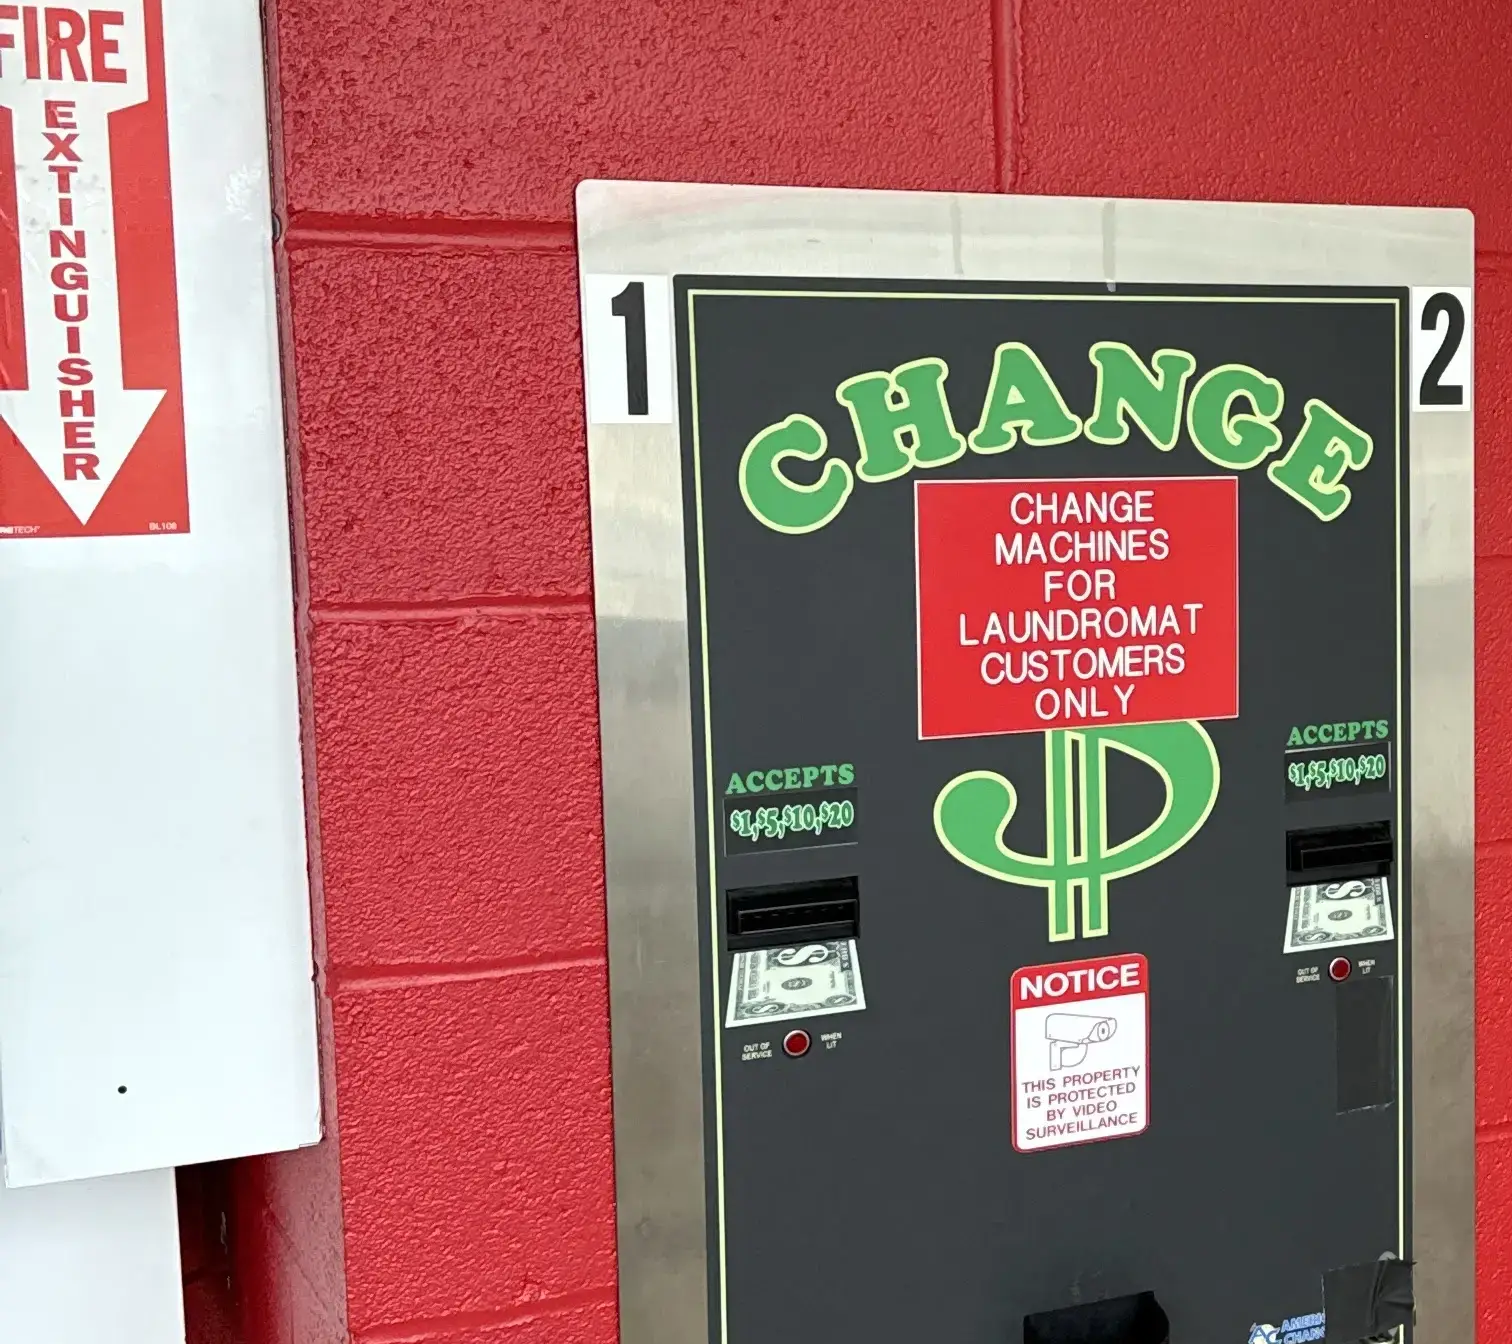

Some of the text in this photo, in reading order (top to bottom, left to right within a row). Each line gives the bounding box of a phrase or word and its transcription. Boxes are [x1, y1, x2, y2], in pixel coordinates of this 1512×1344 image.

[0, 5, 127, 83] FIRE
[42, 99, 100, 480] EXTINGUISHER
[611, 281, 649, 416] 1
[1419, 292, 1465, 406] 2
[739, 341, 1373, 535] CHANGE
[1011, 491, 1154, 525] CHANGE
[995, 528, 1169, 565] MACHINES
[1044, 569, 1116, 602] FOR
[960, 603, 1203, 646] LAUNDROMAT
[981, 643, 1185, 685] CUSTOMERS
[1035, 684, 1135, 720] ONLY
[1287, 720, 1389, 746] ACCEPTS
[725, 763, 855, 795] ACCEPTS
[730, 800, 854, 842] $1,$5,$10,$20
[1020, 963, 1140, 1000] NOTICE
[1022, 1066, 1141, 1094] THIS PROPERTY
[1027, 1082, 1136, 1109] IS PROTECTED
[1026, 1112, 1138, 1140] SURVEILLANCE
[1046, 1100, 1118, 1121] BY VIDEO
